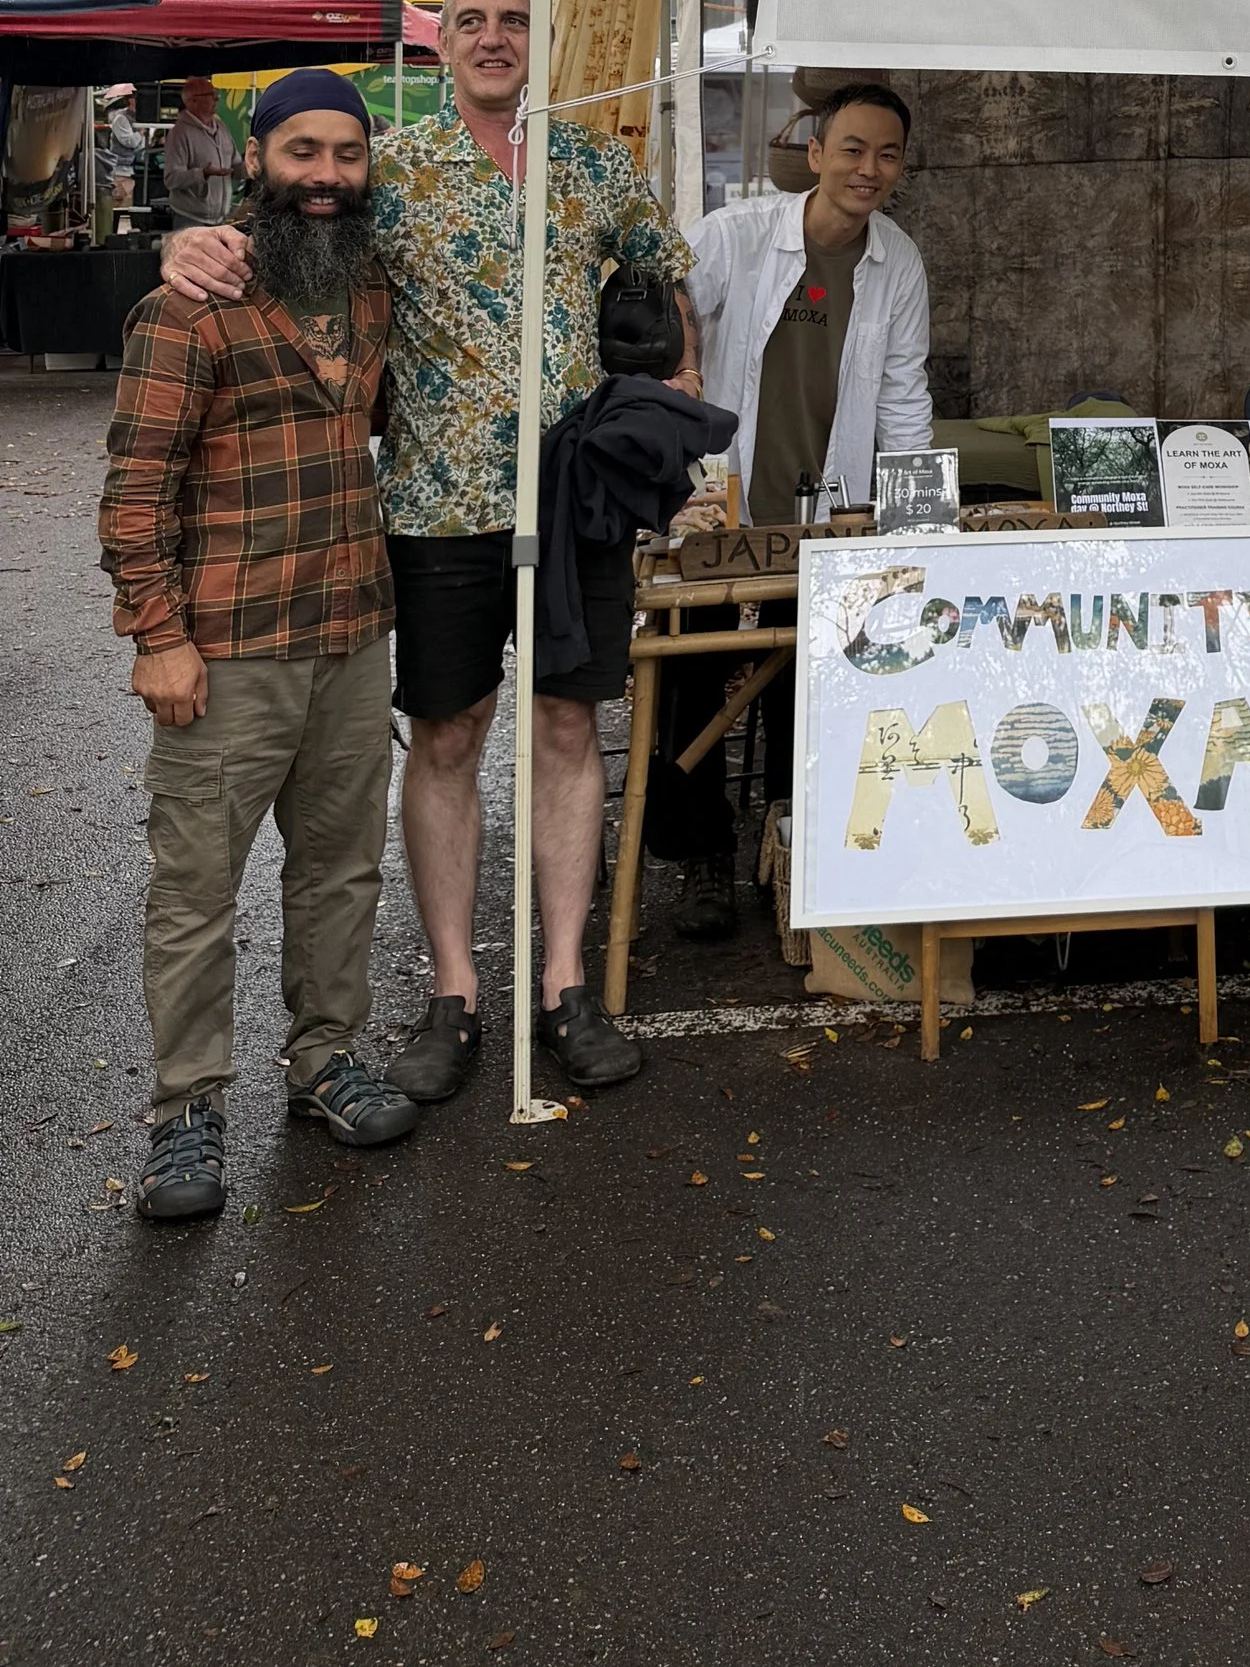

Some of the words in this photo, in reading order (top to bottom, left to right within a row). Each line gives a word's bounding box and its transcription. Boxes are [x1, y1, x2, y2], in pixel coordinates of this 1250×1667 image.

[795, 284, 805, 301] I
[782, 308, 828, 327] MOXA
[1166, 450, 1199, 458] LEARN
[1183, 461, 1197, 470] OF
[1199, 461, 1229, 470] MOXA
[894, 488, 909, 499] 30
[914, 486, 942, 498] mins
[1070, 491, 1120, 505] Community
[1122, 491, 1147, 502] Moxa
[905, 504, 913, 516] $
[916, 503, 932, 514] 20
[1070, 503, 1087, 513] day
[1089, 503, 1099, 512] @
[1100, 500, 1135, 513] Northey
[1136, 500, 1149, 512] St!
[852, 933, 905, 992] AUSTRALIA
